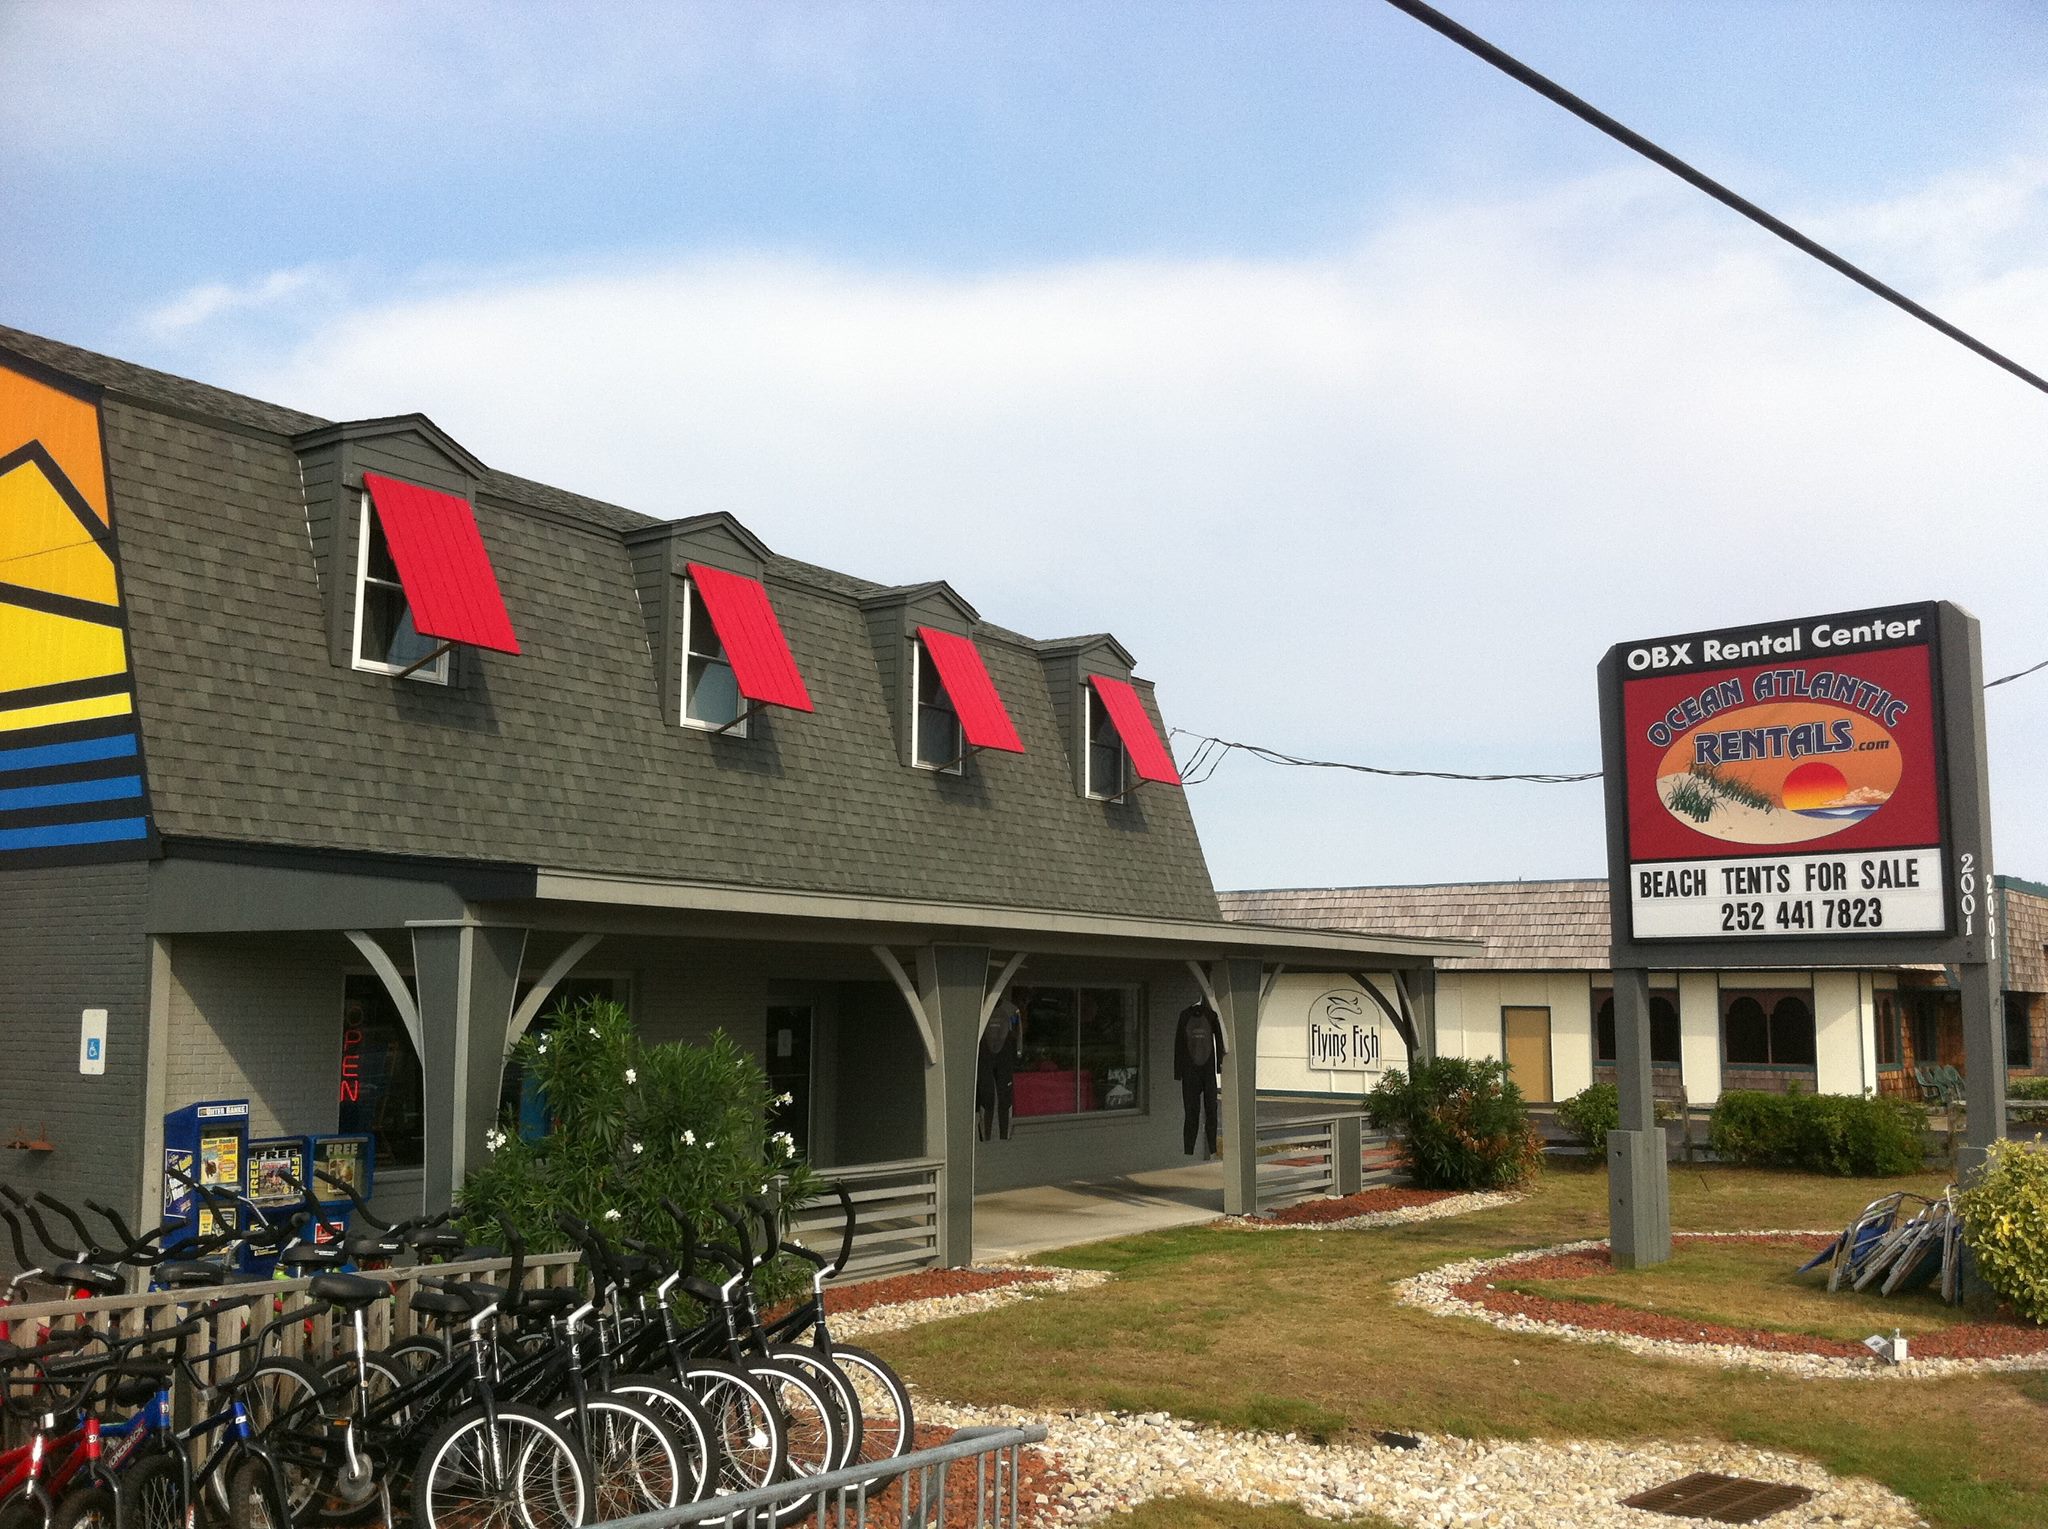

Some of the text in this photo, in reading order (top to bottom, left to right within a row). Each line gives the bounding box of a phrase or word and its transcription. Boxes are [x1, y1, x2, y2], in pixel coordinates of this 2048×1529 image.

[1626, 617, 1922, 672] OBX Rental Center
[1646, 669, 1909, 747] OCEAN ATLANTIC
[1694, 718, 1854, 767] RENTALS
[1639, 858, 1920, 898] BEACH TENTS FOR SALE
[1959, 853, 1976, 937] 2001
[1721, 897, 1883, 931] 252 441 7823
[1985, 874, 1997, 960] 2001
[340, 1005, 363, 1102] OPEN
[1311, 1024, 1379, 1065] Flying Fish
[257, 1149, 298, 1160] FREE
[326, 1143, 359, 1156] FREE
[249, 1160, 259, 1198] FREE
